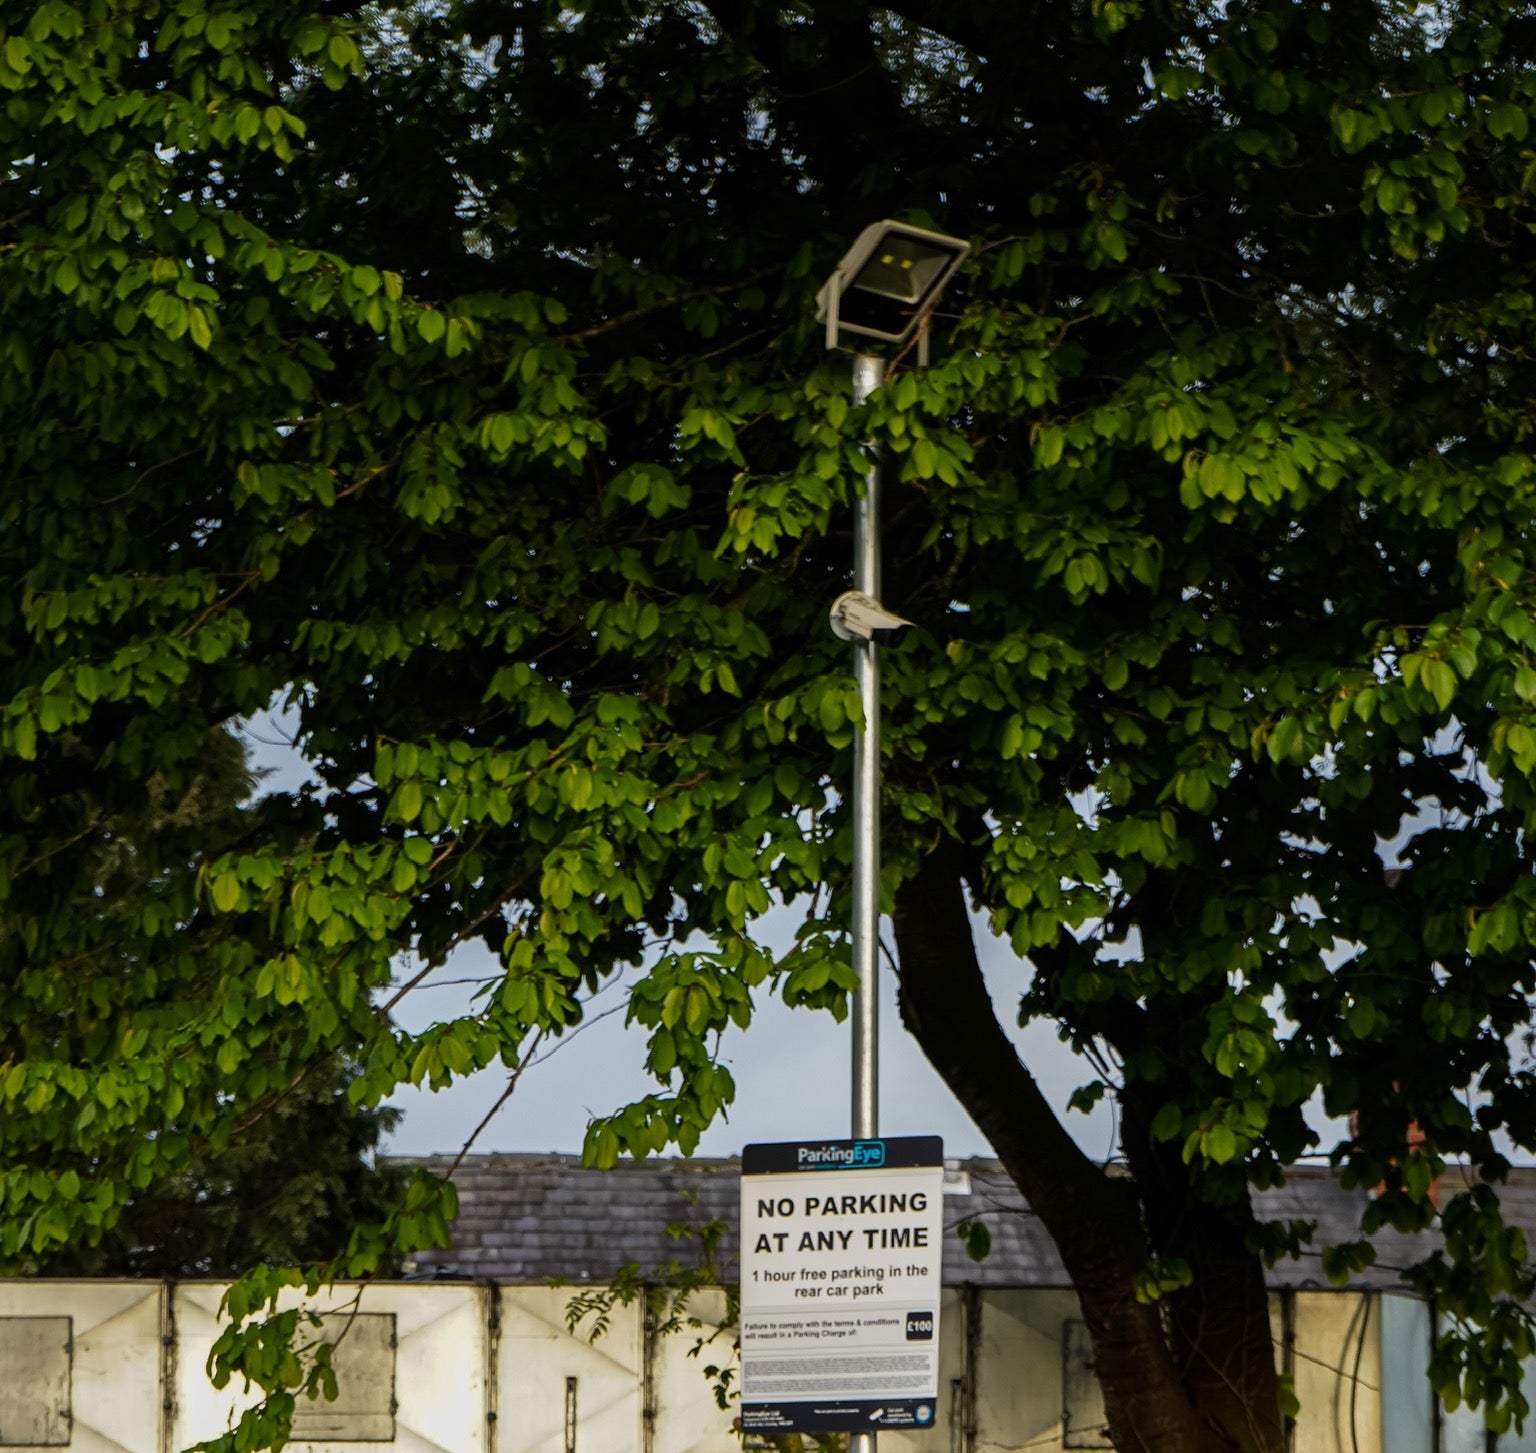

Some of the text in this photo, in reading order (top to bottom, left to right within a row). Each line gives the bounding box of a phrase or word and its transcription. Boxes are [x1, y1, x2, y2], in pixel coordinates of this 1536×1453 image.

[798, 1146, 880, 1164] ParkingEye
[758, 1193, 927, 1218] NO PARKING
[754, 1227, 928, 1253] AT ANY TIME
[753, 1264, 928, 1282] 1 hour free parking in the
[795, 1284, 884, 1300] rear car park
[907, 1321, 932, 1332] £100
